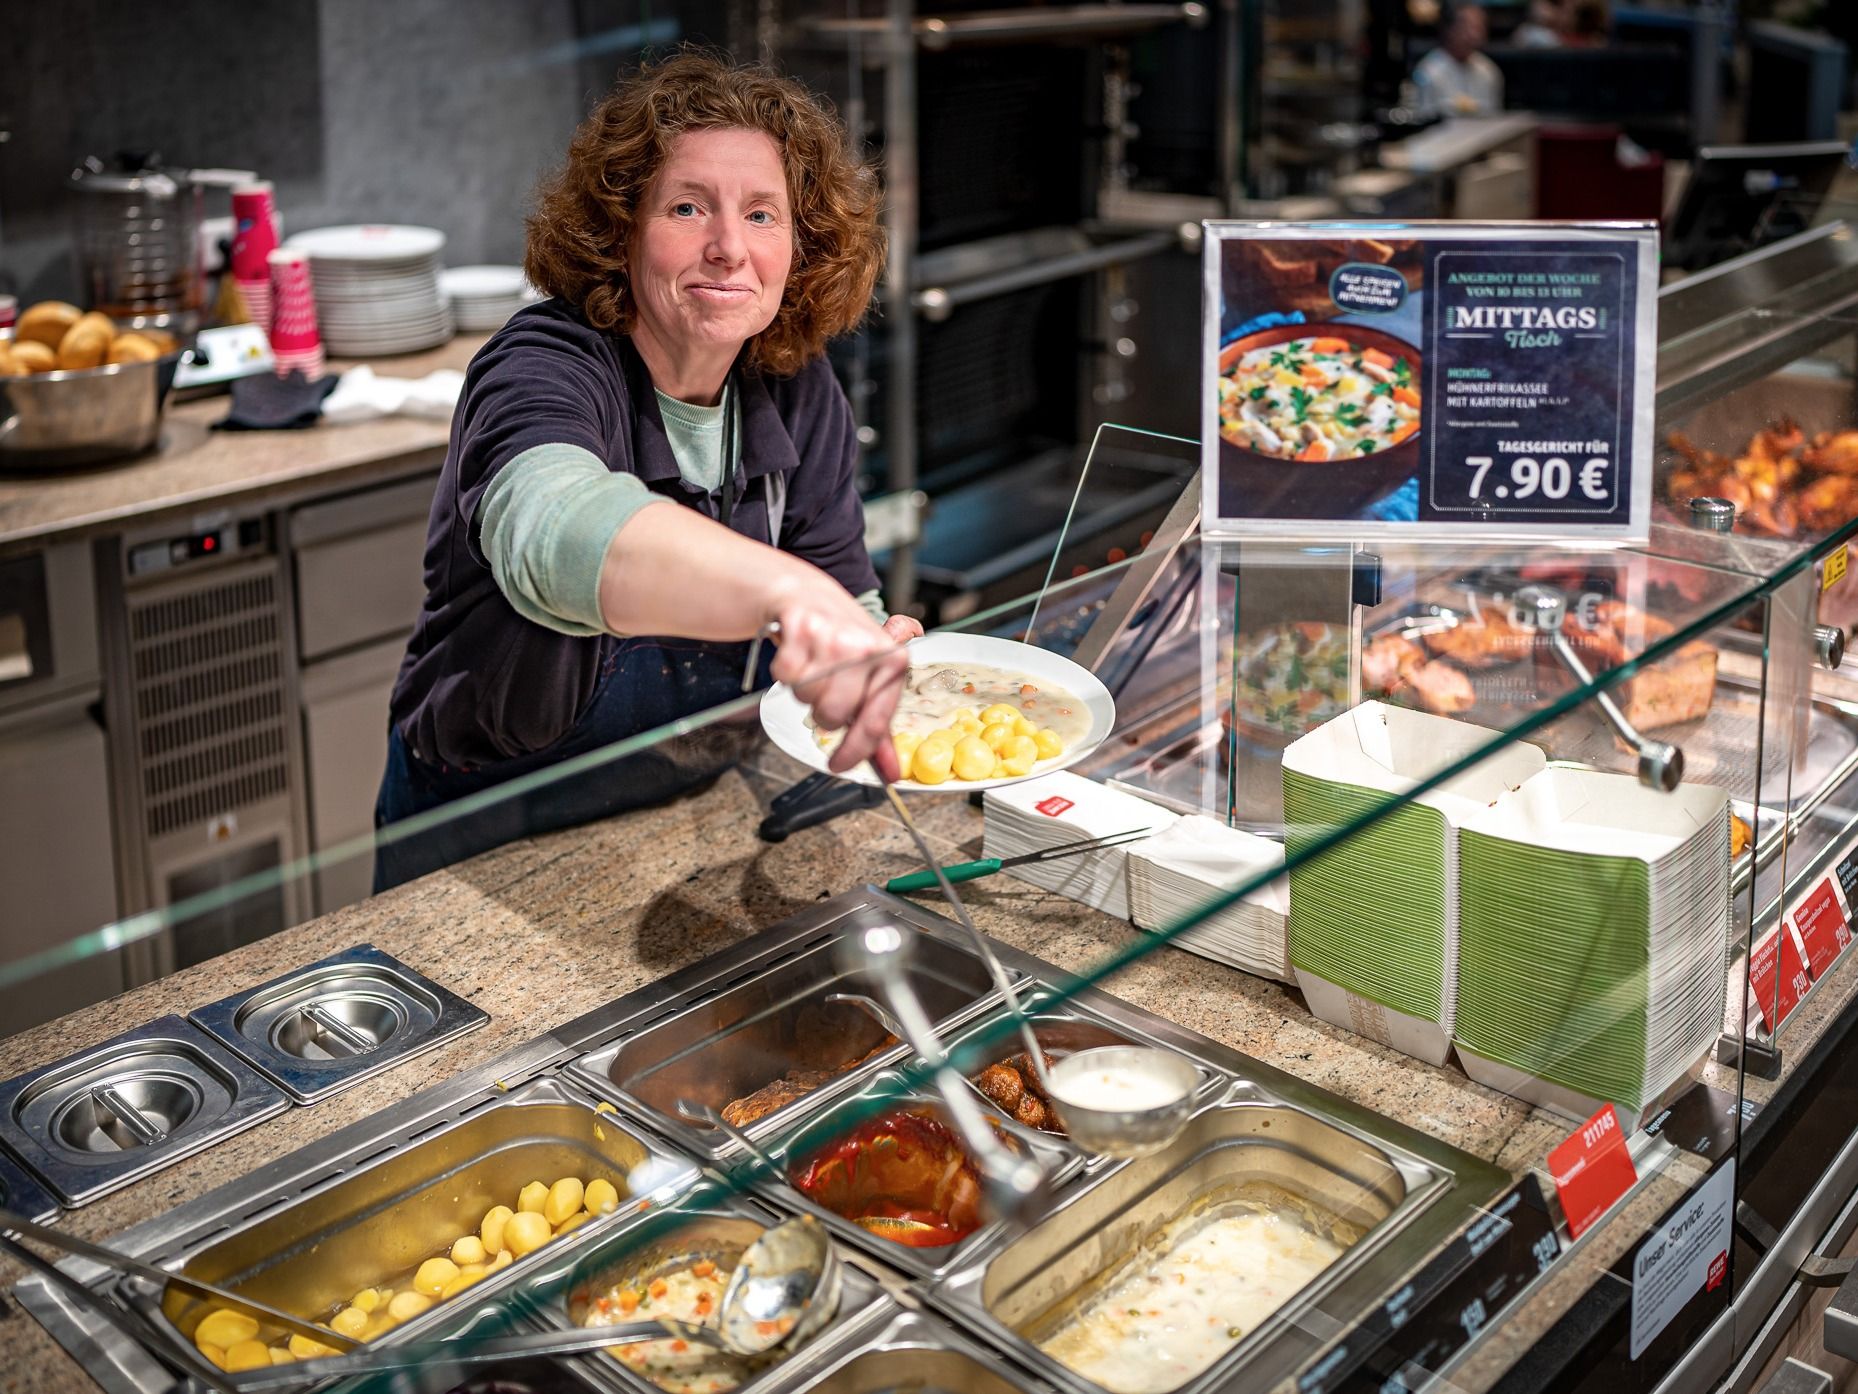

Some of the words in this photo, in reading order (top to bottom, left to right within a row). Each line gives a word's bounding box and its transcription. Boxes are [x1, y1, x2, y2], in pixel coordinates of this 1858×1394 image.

[1448, 273, 1514, 284] ANGEBOT
[1517, 273, 1546, 284] DER
[1549, 273, 1601, 285] WOCHE
[1466, 286, 1495, 297] VON
[1513, 286, 1535, 297] BIS
[1552, 286, 1582, 297] UHR
[1455, 305, 1597, 329] MITTAGS
[1504, 330, 1563, 349] Tisch
[1446, 381, 1549, 395] HÜHNERFRIKASSEE
[1446, 396, 1467, 408] MIT
[1469, 396, 1537, 408] KARTOFFELN
[1498, 440, 1584, 454] TAGESGERICHT
[1585, 439, 1609, 454] FÜR
[1465, 456, 1572, 499] 7.90
[1578, 458, 1609, 500] €
[1582, 1109, 1616, 1149] 211745
[1638, 1238, 1667, 1278] Unser
[1668, 1202, 1705, 1249] Service:
